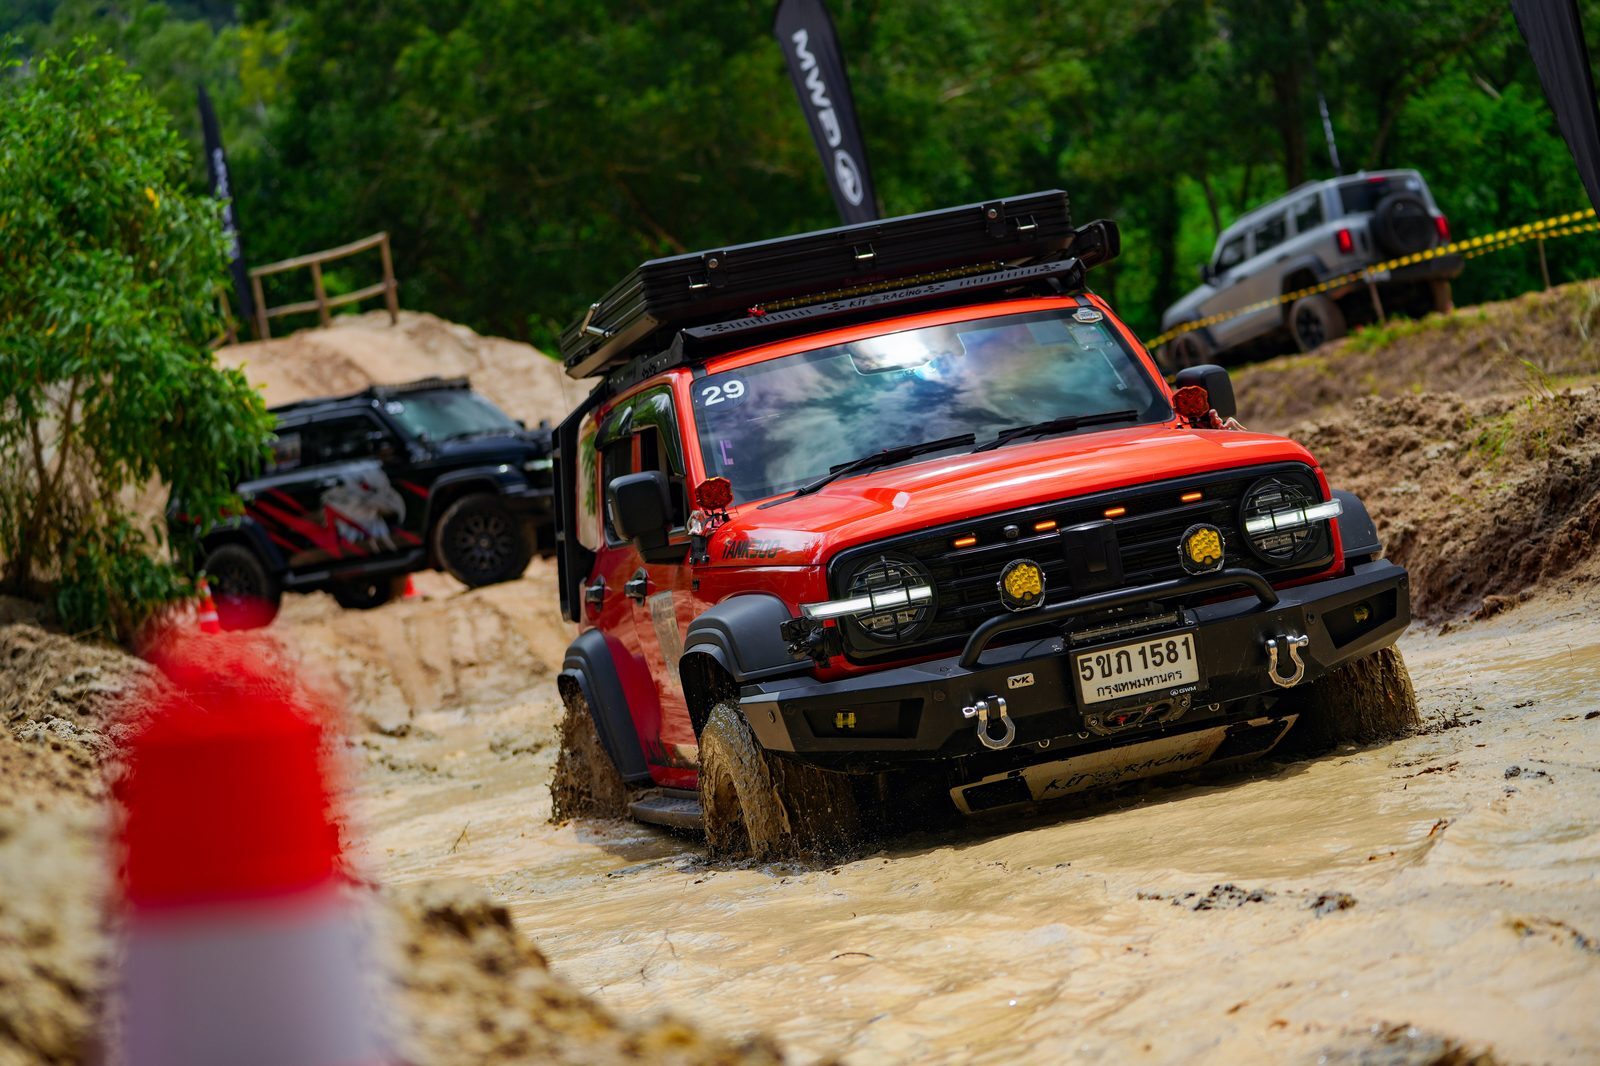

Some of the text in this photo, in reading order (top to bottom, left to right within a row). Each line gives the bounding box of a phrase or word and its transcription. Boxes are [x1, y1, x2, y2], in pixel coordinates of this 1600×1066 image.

[702, 380, 745, 406] 29
[1138, 637, 1191, 669] 1581
[1097, 670, 1182, 697] กรุงเทพมหานคร
